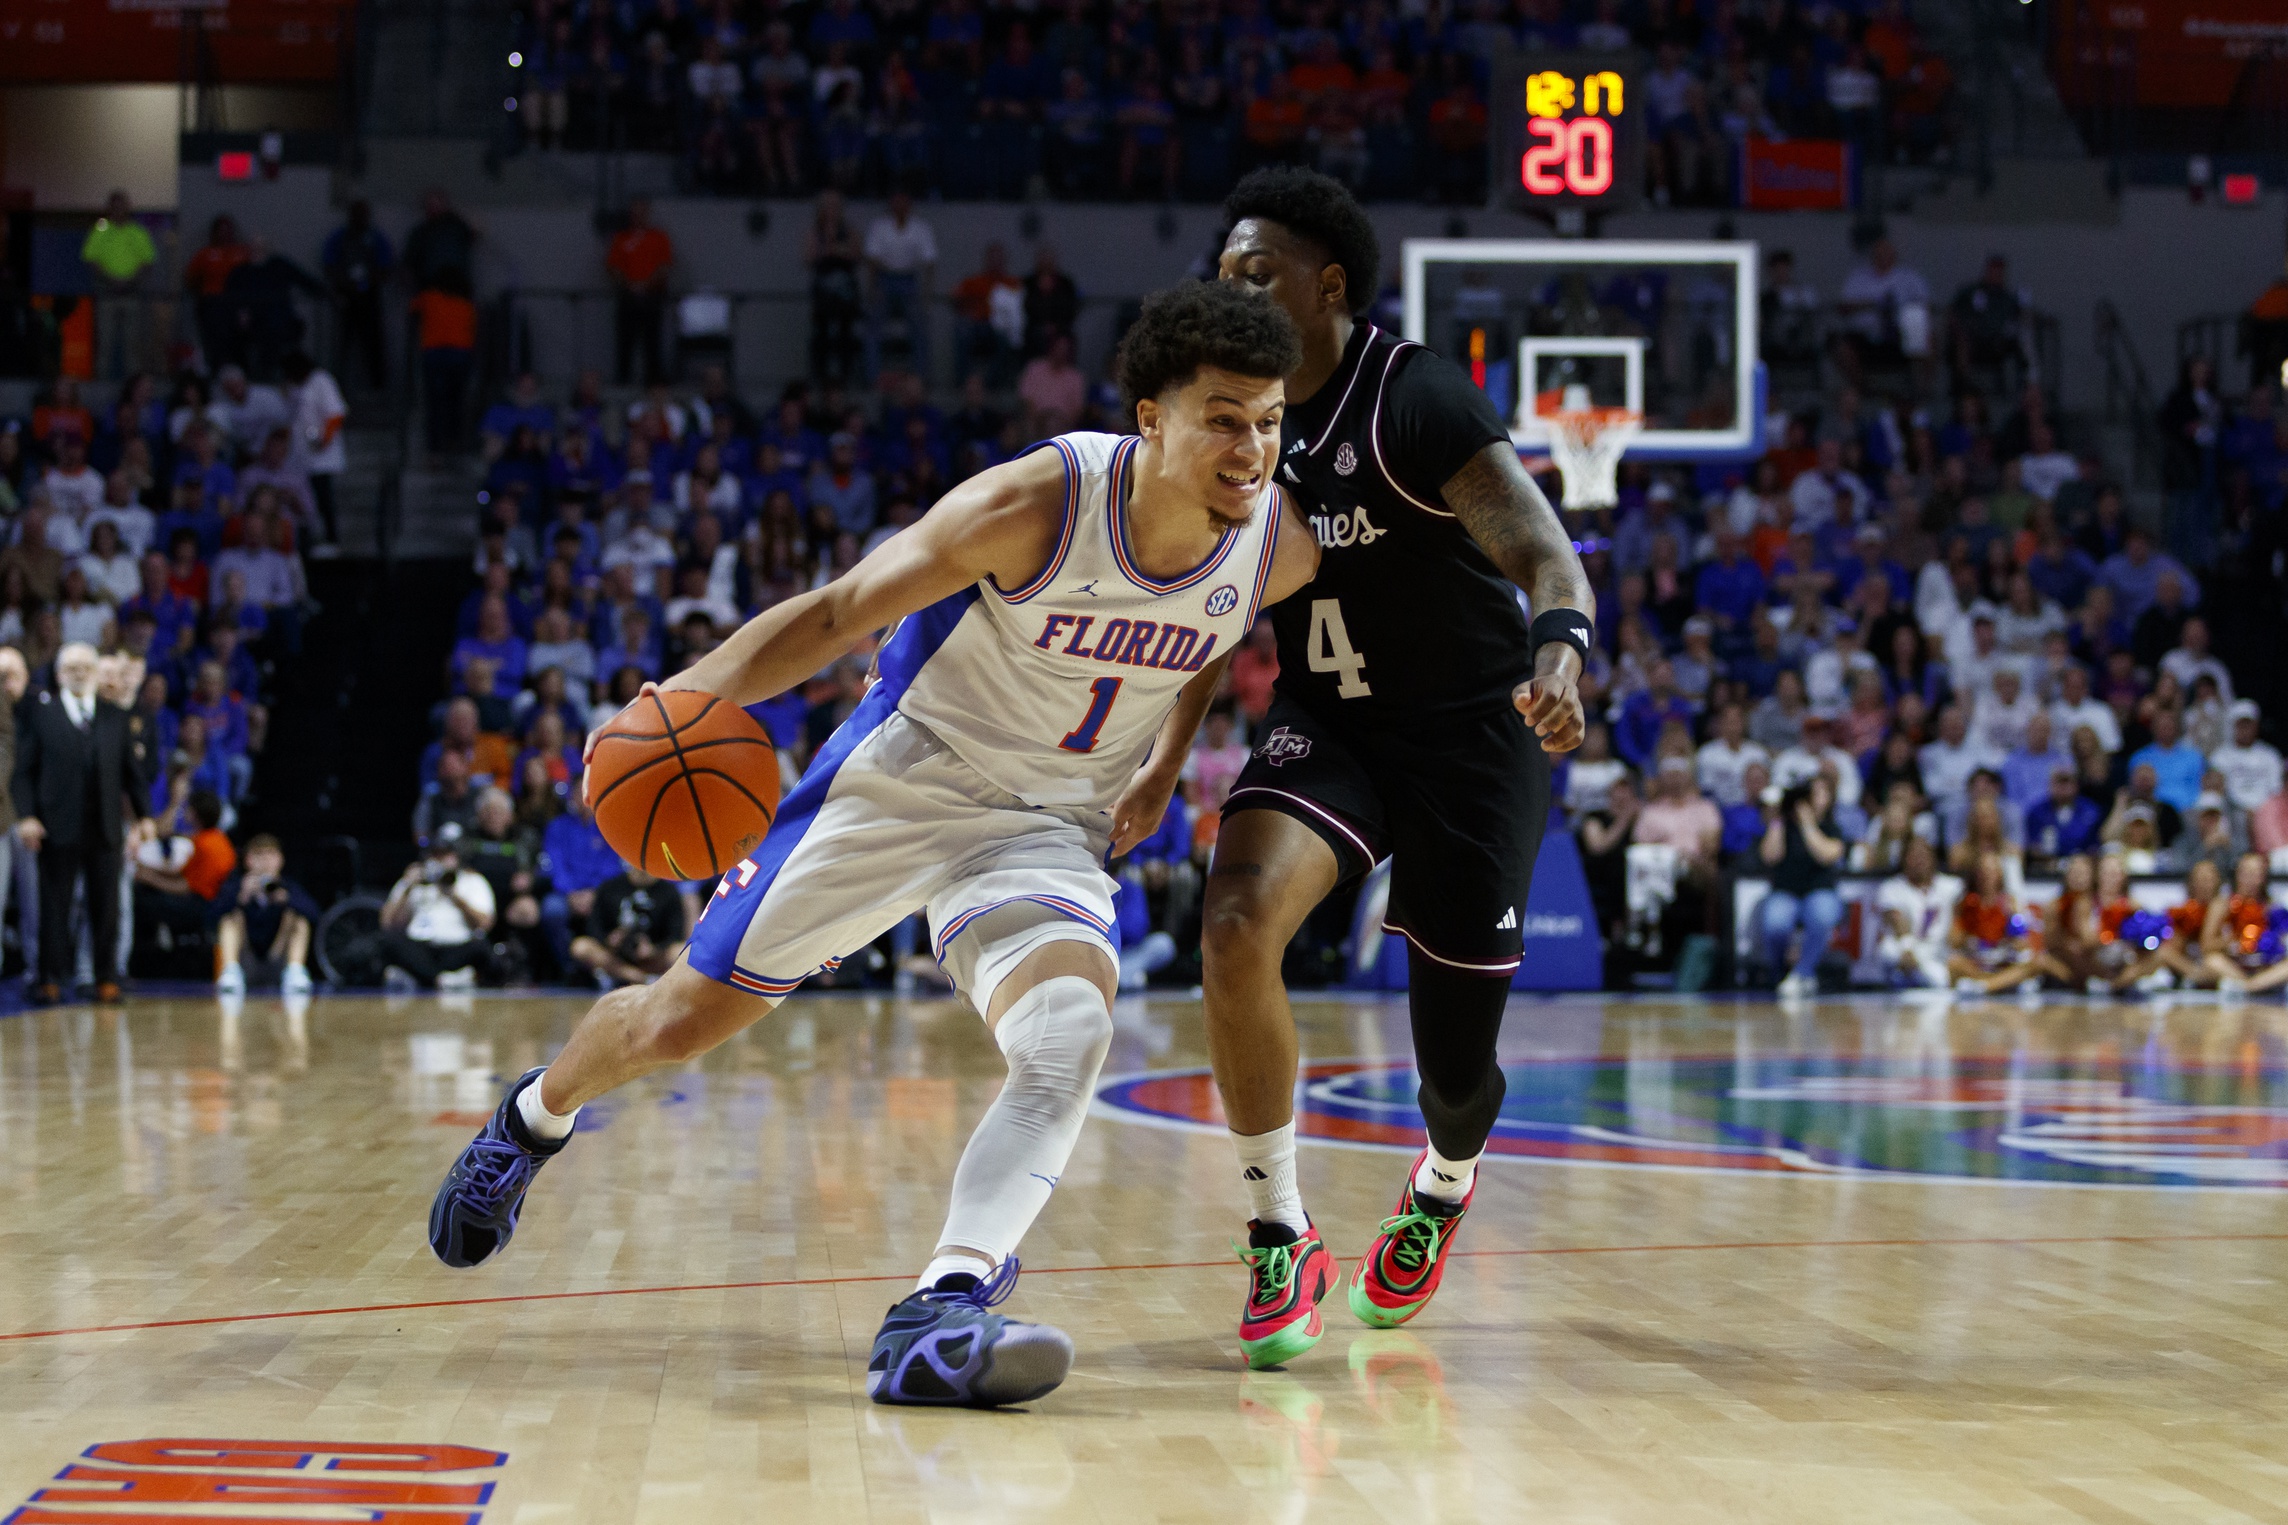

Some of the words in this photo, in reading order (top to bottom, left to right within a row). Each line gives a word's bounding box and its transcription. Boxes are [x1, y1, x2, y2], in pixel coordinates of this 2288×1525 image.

[1522, 117, 1613, 195] 20
[1207, 587, 1237, 615] SEC
[1033, 613, 1219, 673] FLORIDA
[1307, 598, 1373, 700] 4
[1058, 676, 1124, 753] 1
